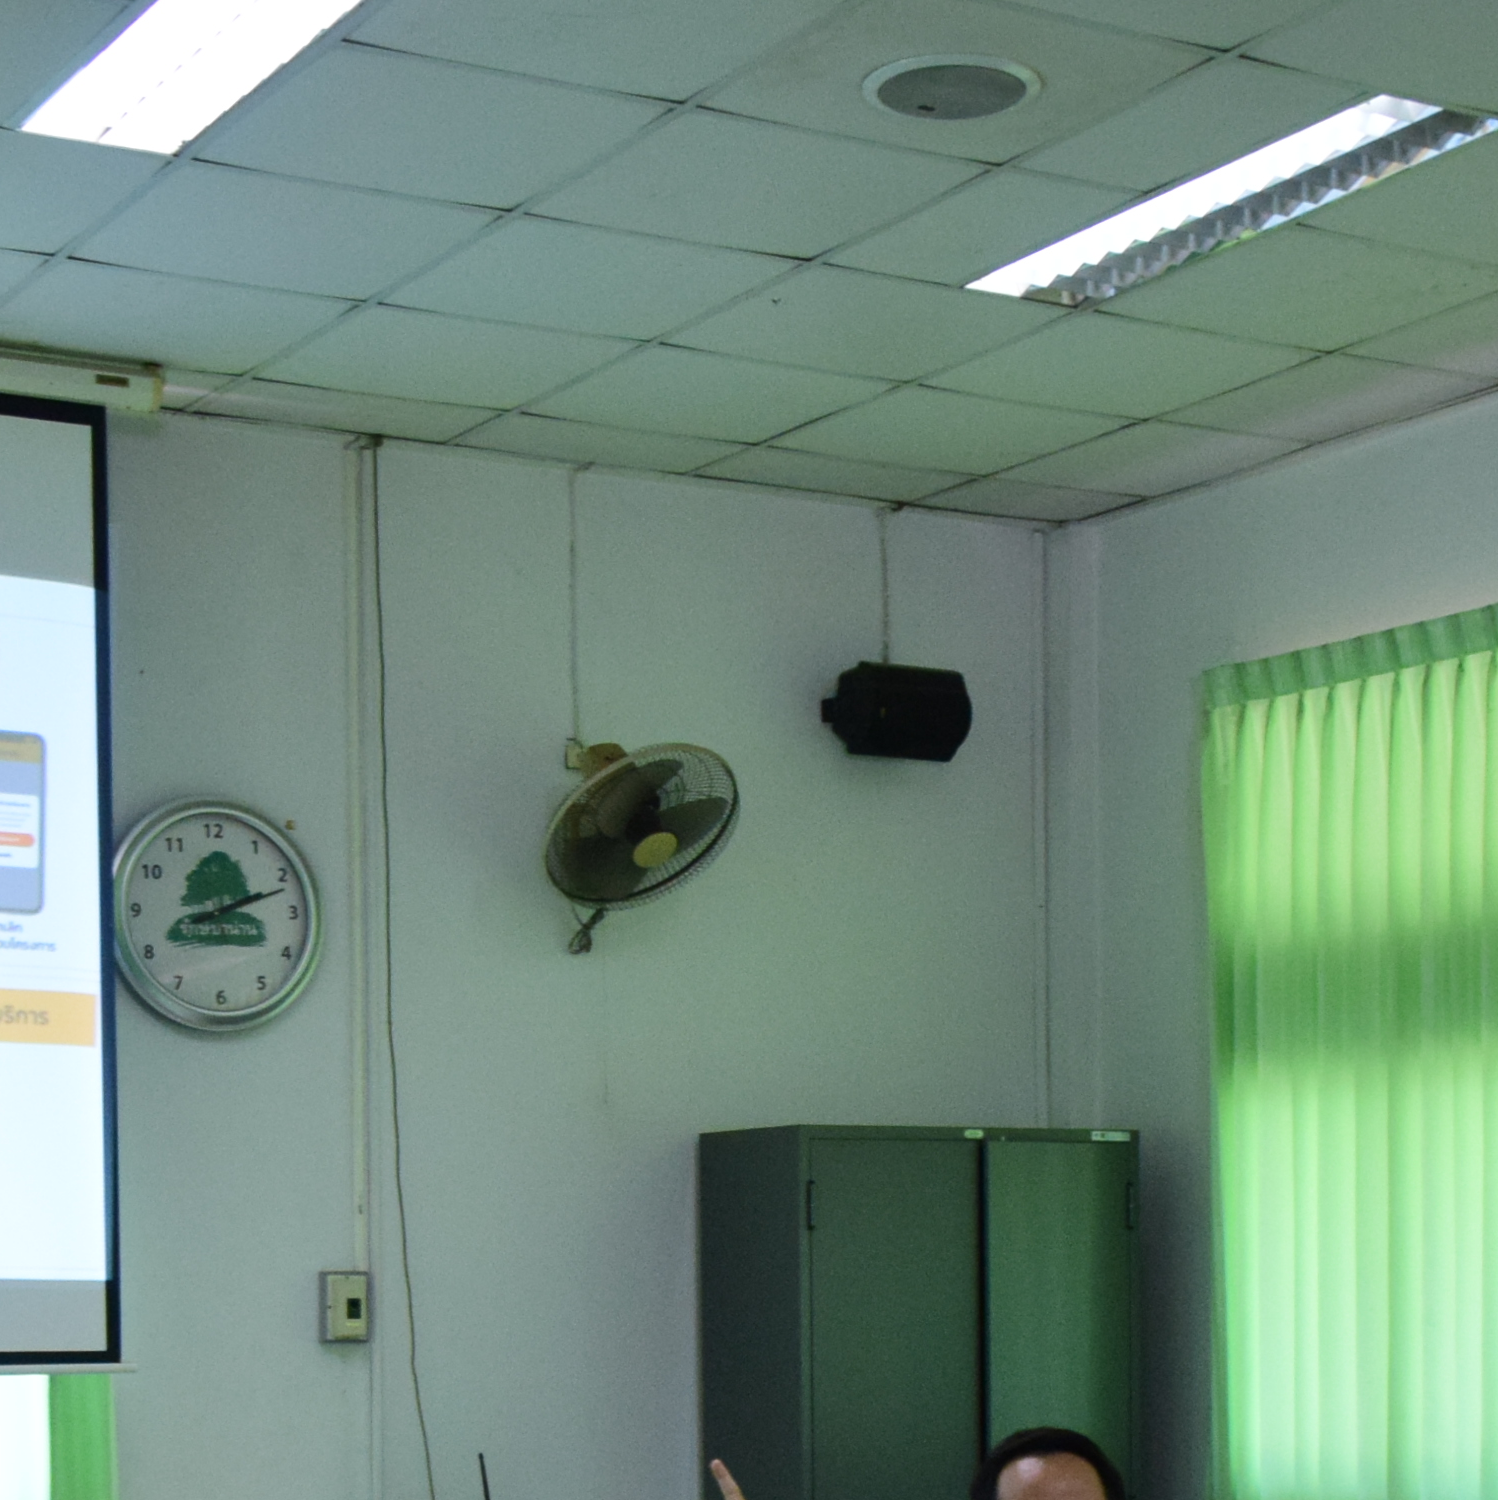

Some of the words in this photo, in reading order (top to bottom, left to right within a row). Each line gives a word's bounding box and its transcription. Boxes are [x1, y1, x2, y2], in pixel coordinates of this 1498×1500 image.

[203, 824, 224, 839] 12
[166, 838, 184, 852] 11
[252, 841, 259, 854] 1
[142, 864, 162, 880] 10
[278, 868, 288, 883] 2
[131, 903, 142, 918] 9
[289, 905, 299, 920] 3
[144, 945, 155, 960] 8
[281, 946, 292, 960] 4
[173, 976, 184, 990] 7
[257, 976, 267, 991] 5
[216, 990, 227, 1005] 6
